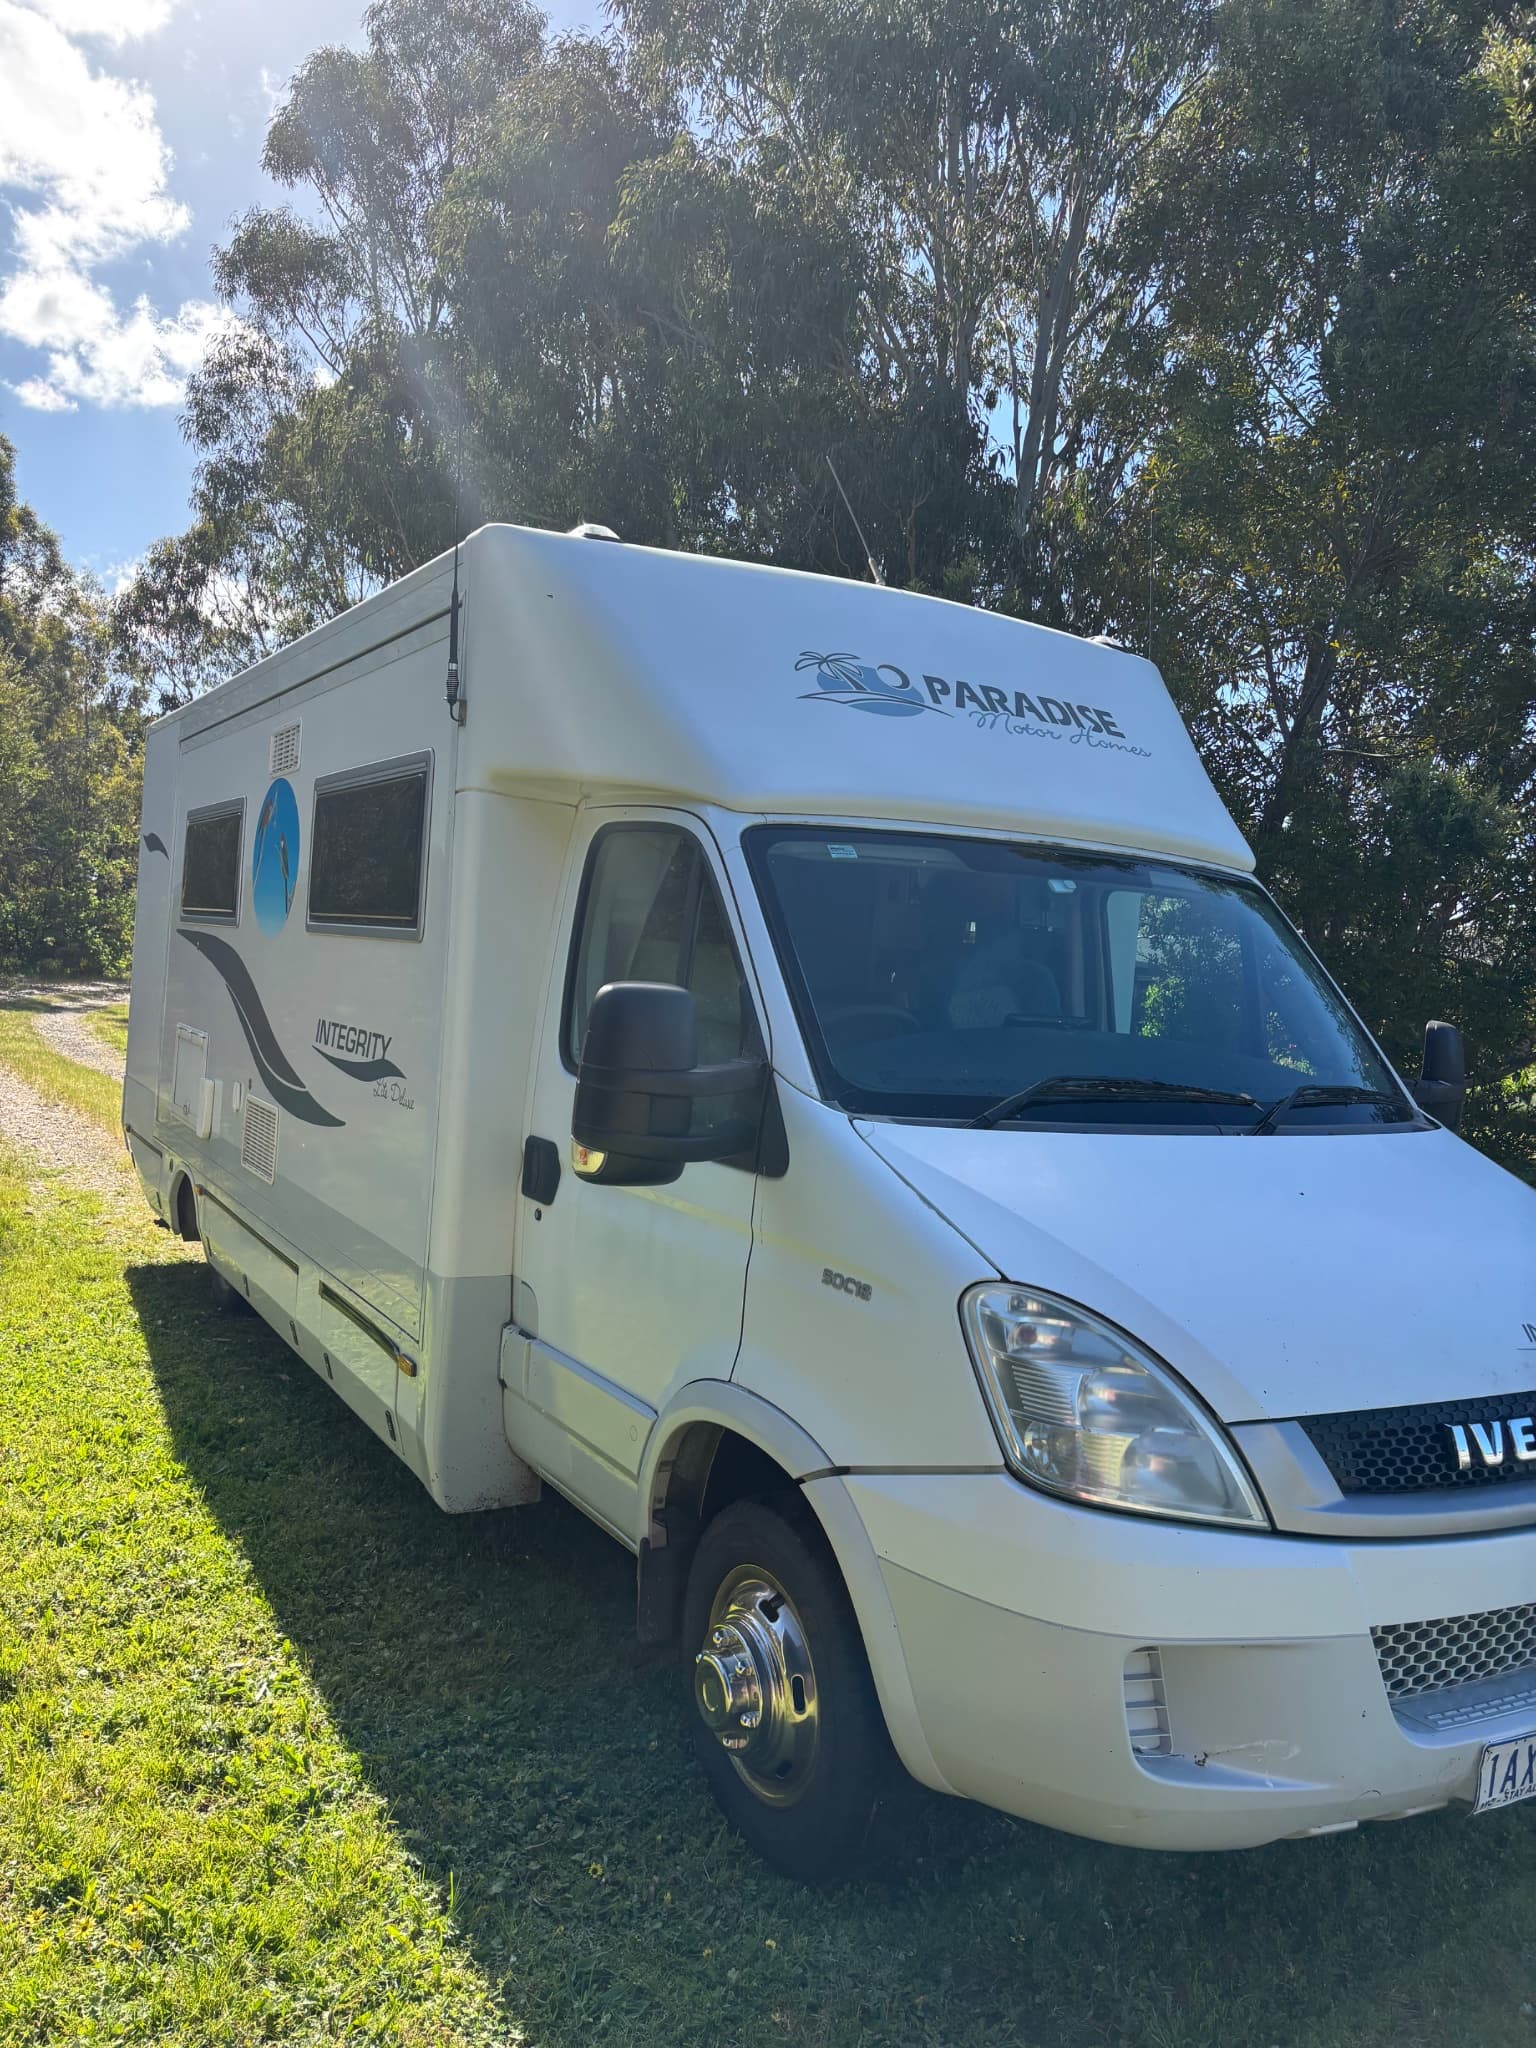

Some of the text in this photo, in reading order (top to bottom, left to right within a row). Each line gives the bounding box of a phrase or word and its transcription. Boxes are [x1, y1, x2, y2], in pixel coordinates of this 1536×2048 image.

[922, 674, 1126, 739] PARADISE
[968, 711, 1152, 757] Motor Homes
[315, 1018, 392, 1060] INTEGRITY
